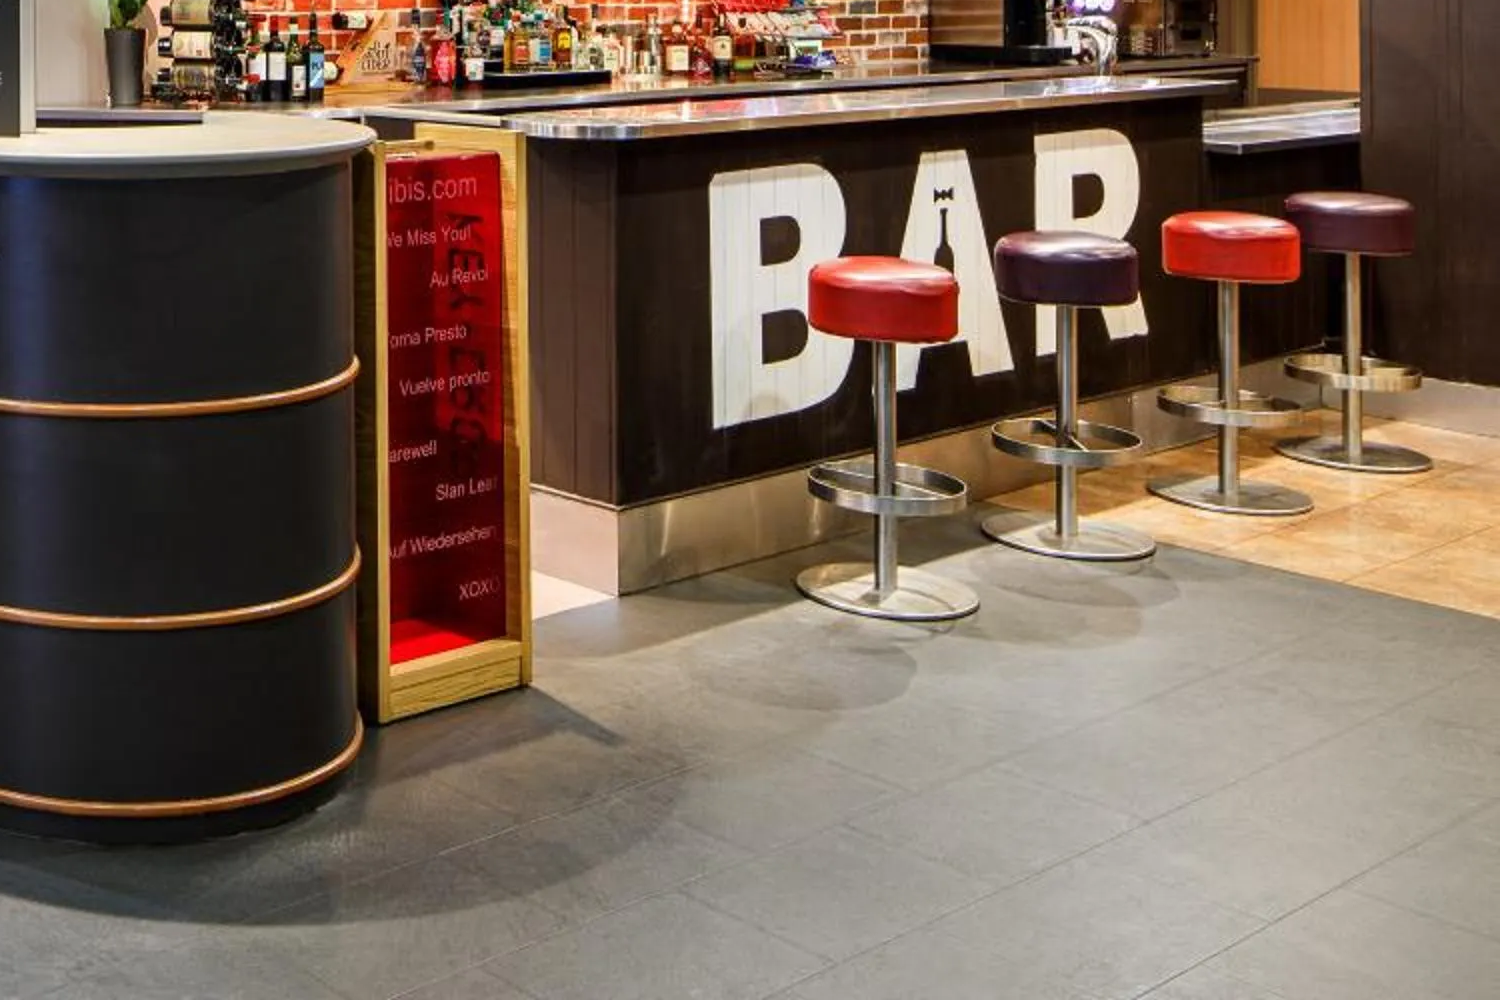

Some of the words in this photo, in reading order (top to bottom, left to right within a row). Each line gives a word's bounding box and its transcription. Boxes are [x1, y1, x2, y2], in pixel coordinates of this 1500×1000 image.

[388, 175, 478, 206] ibis.com
[406, 226, 438, 248] Miss
[708, 127, 1150, 431] BAR
[425, 323, 467, 344] Presto
[388, 439, 437, 463] arewell
